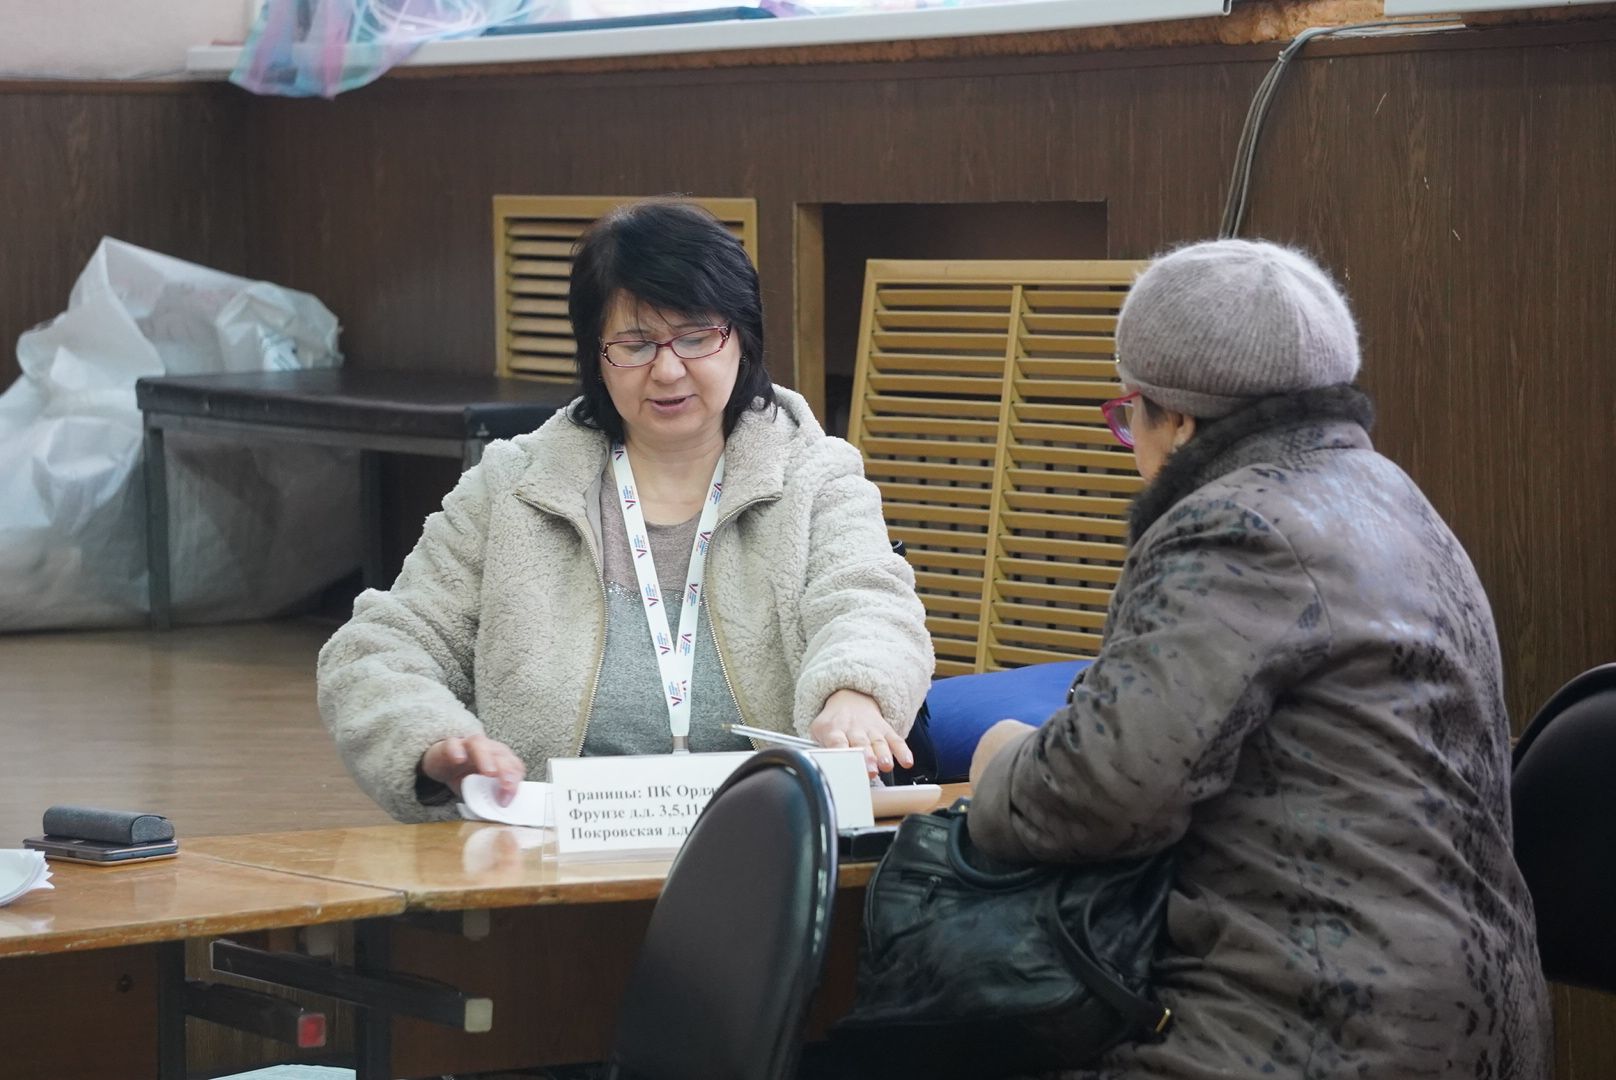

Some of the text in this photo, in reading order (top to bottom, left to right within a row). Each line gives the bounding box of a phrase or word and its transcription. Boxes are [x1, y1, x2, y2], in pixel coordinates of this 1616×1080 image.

[567, 788, 642, 804] Границы:
[647, 785, 671, 798] ПК
[568, 807, 626, 823] Фрунзе
[570, 826, 663, 842] Покровская
